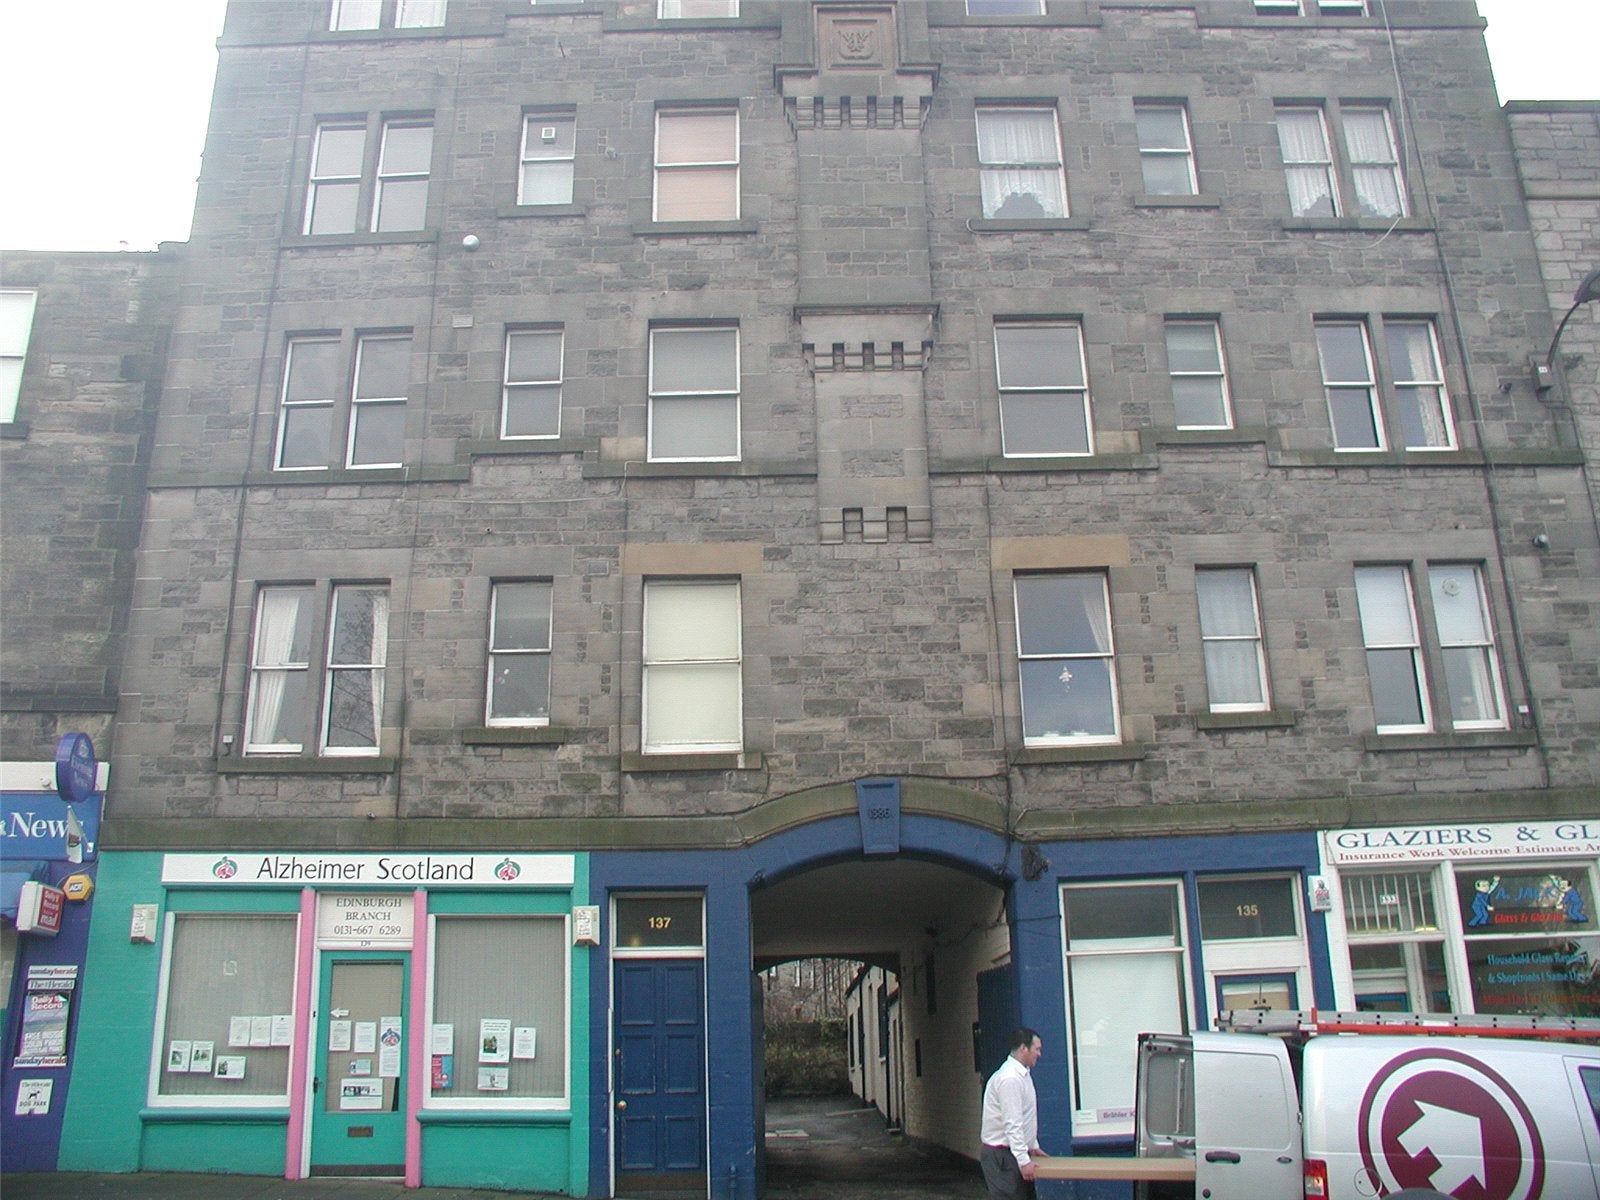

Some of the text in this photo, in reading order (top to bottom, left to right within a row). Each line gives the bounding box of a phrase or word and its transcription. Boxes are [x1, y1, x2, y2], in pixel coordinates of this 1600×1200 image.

[8, 812, 83, 838] New
[1336, 824, 1600, 849] GLAZIERS & GL
[1340, 851, 1405, 861] Insurance
[1409, 849, 1444, 858] Work
[1448, 847, 1510, 856] Welcome
[1516, 844, 1582, 854] Estimates
[257, 856, 474, 880] Alzheimer Scotland
[336, 898, 402, 907] EDINBURGH
[345, 911, 391, 921] BRANCH
[1237, 904, 1258, 916] 135
[649, 917, 671, 929] 137
[334, 925, 401, 935] 0131-667 6289
[31, 1002, 62, 1010] Record
